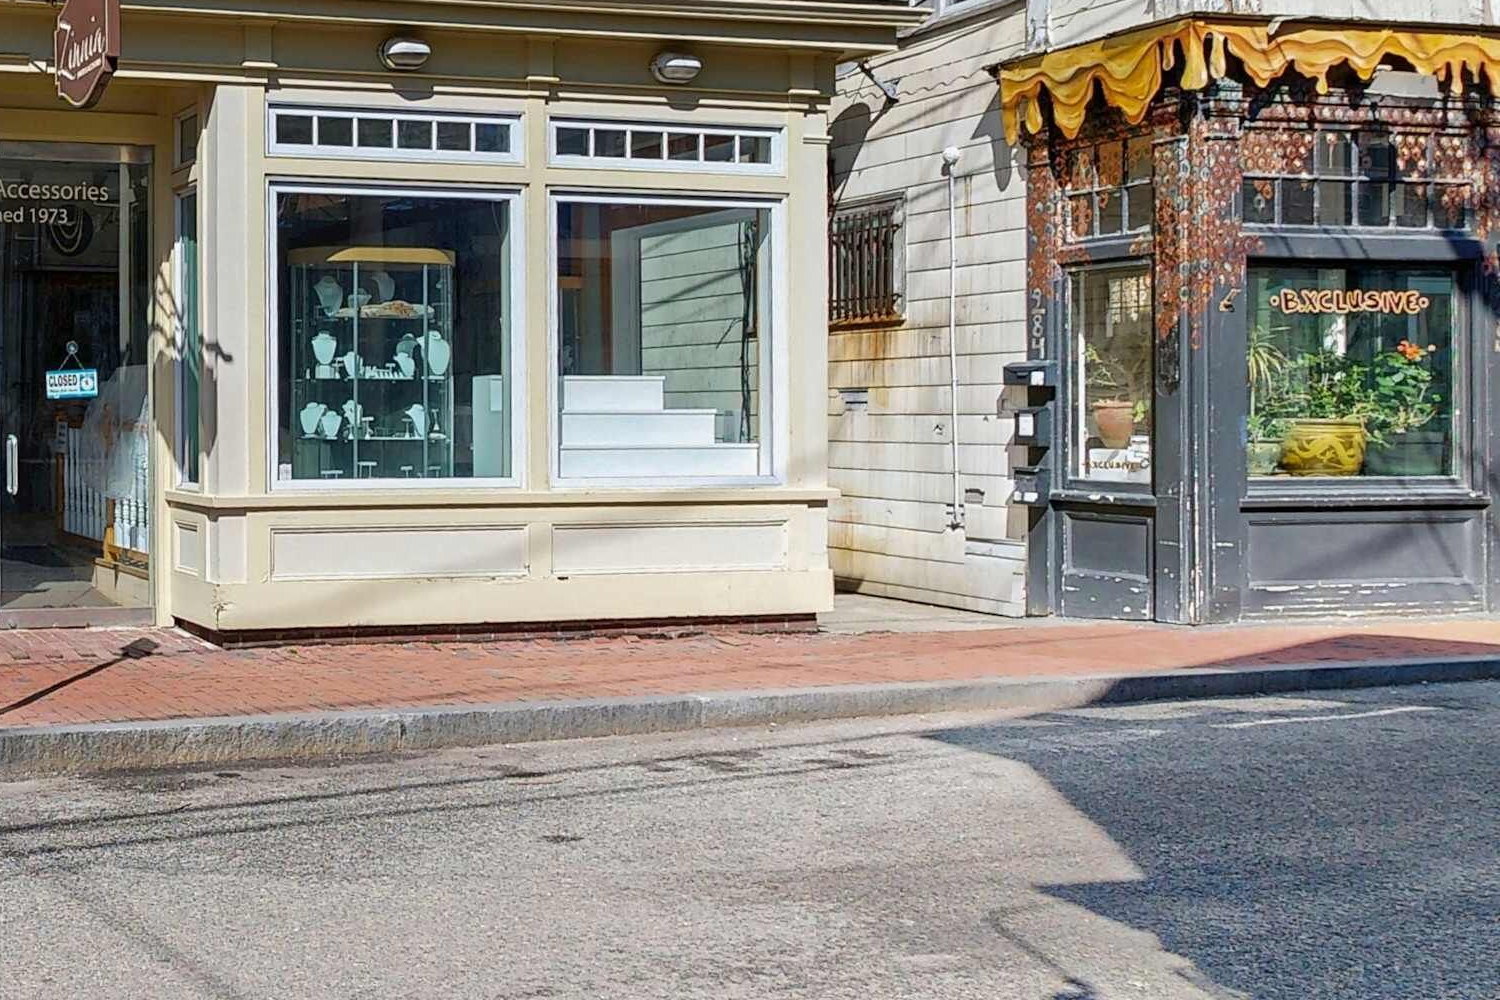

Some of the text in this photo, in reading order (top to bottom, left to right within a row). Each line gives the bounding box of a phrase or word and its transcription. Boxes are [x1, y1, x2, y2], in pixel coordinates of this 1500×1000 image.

[58, 15, 106, 80] Zinnia
[29, 208, 68, 225] 1973
[49, 374, 78, 387] CLOSED
